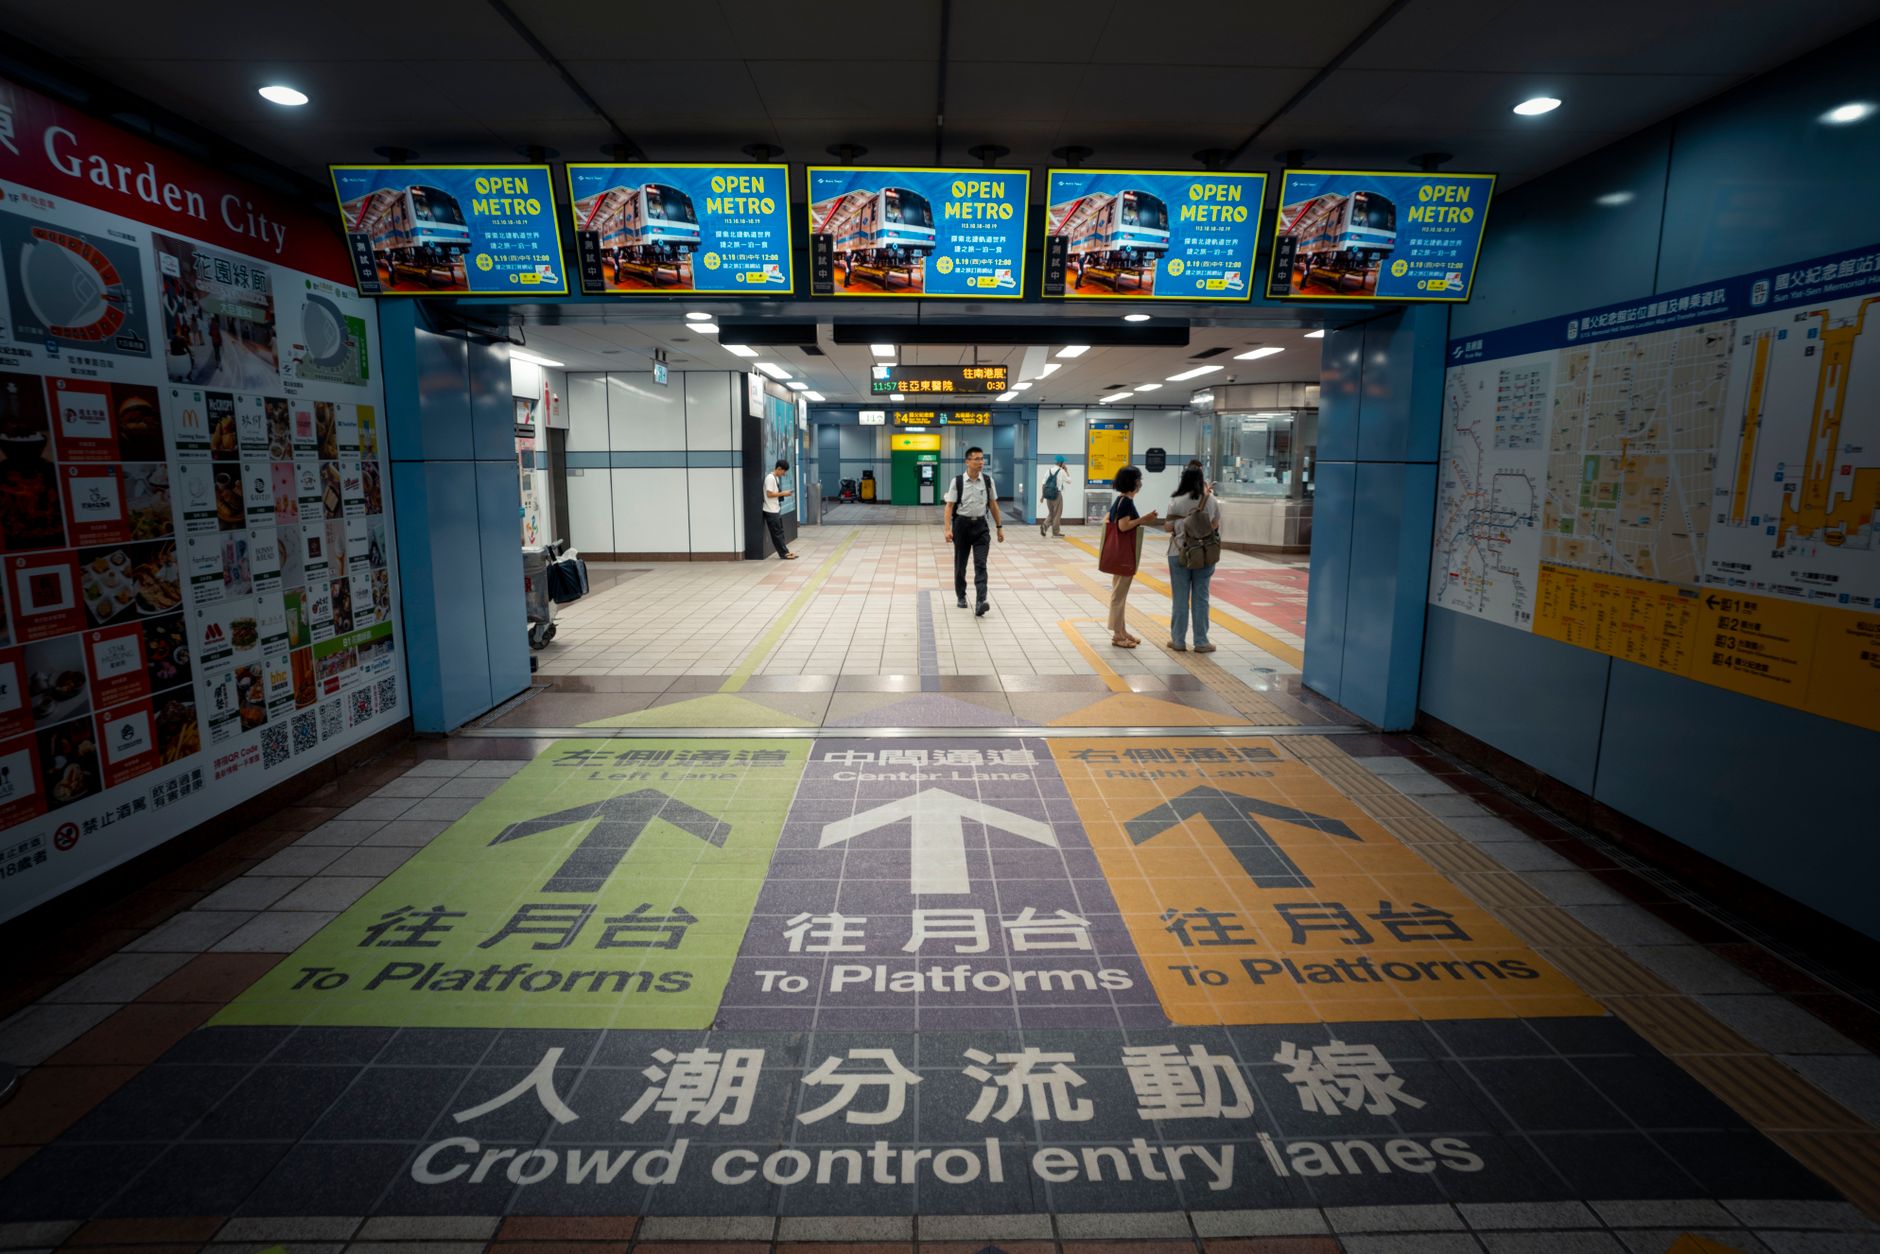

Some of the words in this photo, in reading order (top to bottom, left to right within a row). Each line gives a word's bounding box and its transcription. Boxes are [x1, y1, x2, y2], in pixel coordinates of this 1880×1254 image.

[43, 125, 208, 222] Garden
[220, 193, 288, 255] City
[474, 177, 529, 195] OPEN
[710, 175, 765, 193] OPEN
[951, 180, 1005, 199] OPEN
[1189, 184, 1242, 202] OPEN
[1418, 185, 1471, 203] OPEN
[472, 198, 541, 216] METRO
[706, 197, 775, 215] METRO
[944, 202, 1014, 220] METRO
[1180, 205, 1248, 223] METRO
[1407, 206, 1474, 224] METRO
[192, 252, 267, 293] 花園綠廊
[963, 368, 1006, 379] 往南港展
[873, 382, 897, 391] 11:57
[898, 381, 953, 392] 往亞東醫院
[986, 381, 1006, 391] 0:30
[901, 413, 909, 424] 4
[976, 413, 984, 424] 3
[1730, 617, 1740, 631] 2
[1727, 636, 1736, 650] 3
[1725, 655, 1733, 668] 4
[553, 749, 790, 767] 左側通道
[824, 749, 1039, 766] 中間通道
[1068, 747, 1284, 764] 右側通道
[152, 768, 203, 799] 飲酒過量
[588, 771, 650, 782] Left
[657, 771, 738, 782] Lane
[832, 771, 942, 781] Center
[952, 771, 1033, 781] Lane
[1104, 768, 1187, 781] Right
[1195, 768, 1275, 778] Lane
[153, 779, 204, 808] 有害健康
[82, 795, 147, 837] 禁止酒駕
[357, 903, 699, 950] 往月台
[783, 907, 1092, 954] 往月台
[1160, 901, 1473, 947] 往月台
[290, 966, 350, 992] To
[362, 962, 692, 993] Platforms
[754, 970, 809, 993] To
[829, 964, 1134, 993] Platforms
[1167, 964, 1229, 987] To
[1240, 957, 1540, 985] Platforms
[451, 1040, 1427, 1126] 人潮分流動線
[410, 1136, 690, 1186] Crowd
[711, 1137, 1004, 1186] control
[1032, 1137, 1235, 1191] entry
[1255, 1130, 1485, 1178] lanes
